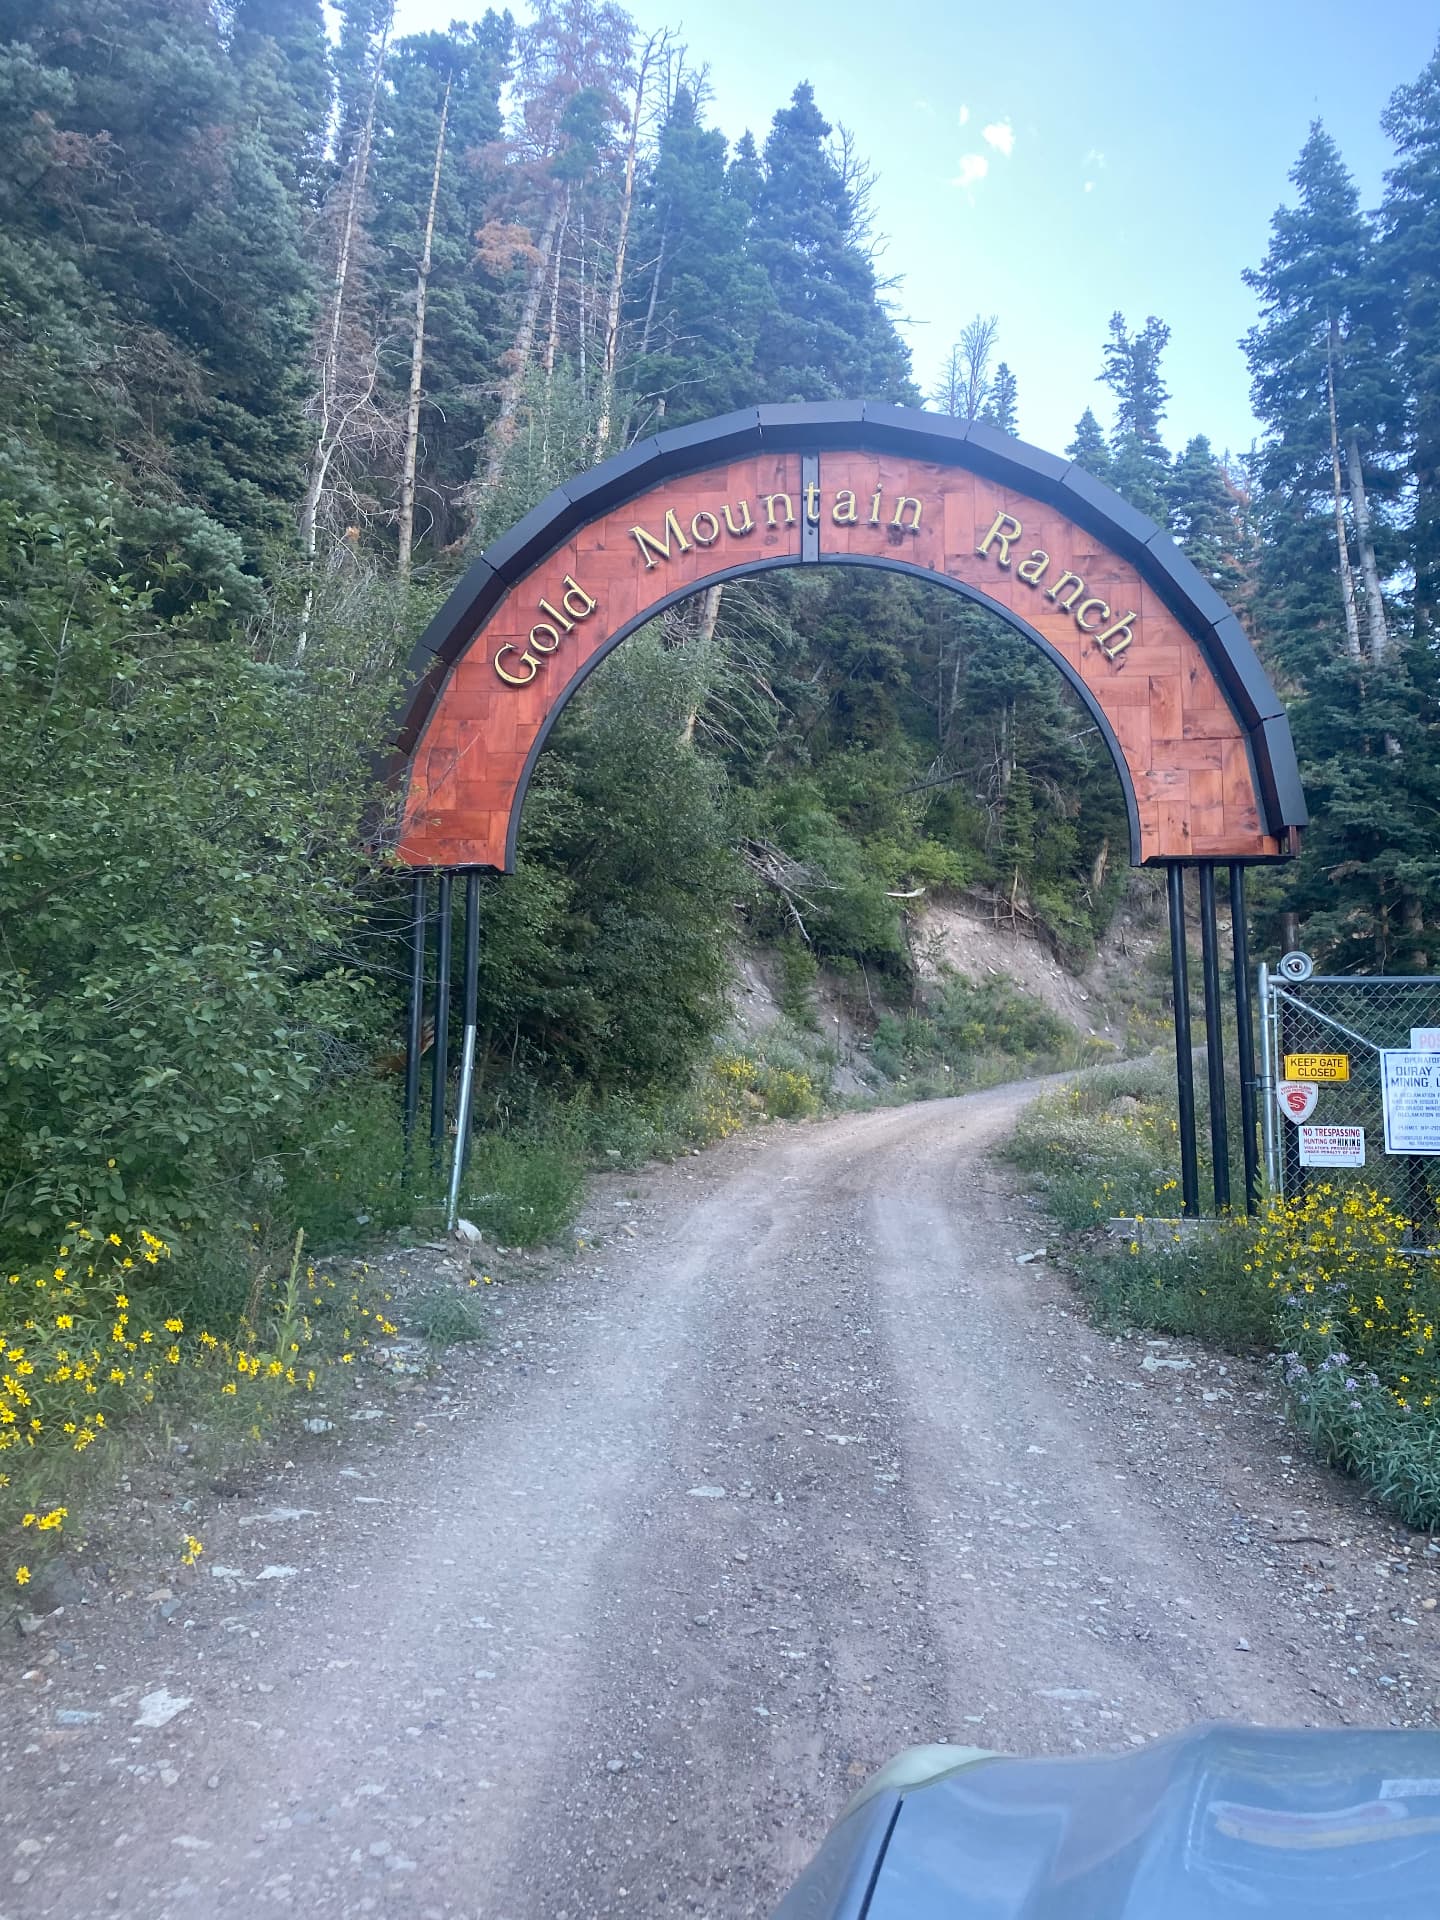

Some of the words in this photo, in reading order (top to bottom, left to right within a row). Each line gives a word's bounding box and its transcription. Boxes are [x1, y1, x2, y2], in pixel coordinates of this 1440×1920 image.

[493, 574, 599, 688] Gold
[629, 481, 923, 569] Mountain
[975, 511, 1138, 661] Ranch
[1290, 1058, 1317, 1067] KEEP
[1319, 1059, 1344, 1068] GATE
[1298, 1068, 1337, 1077] CLOSED
[1303, 1128, 1313, 1137] NO
[1315, 1128, 1361, 1138] TRESPASSING
[1337, 1138, 1361, 1147] HIKING
